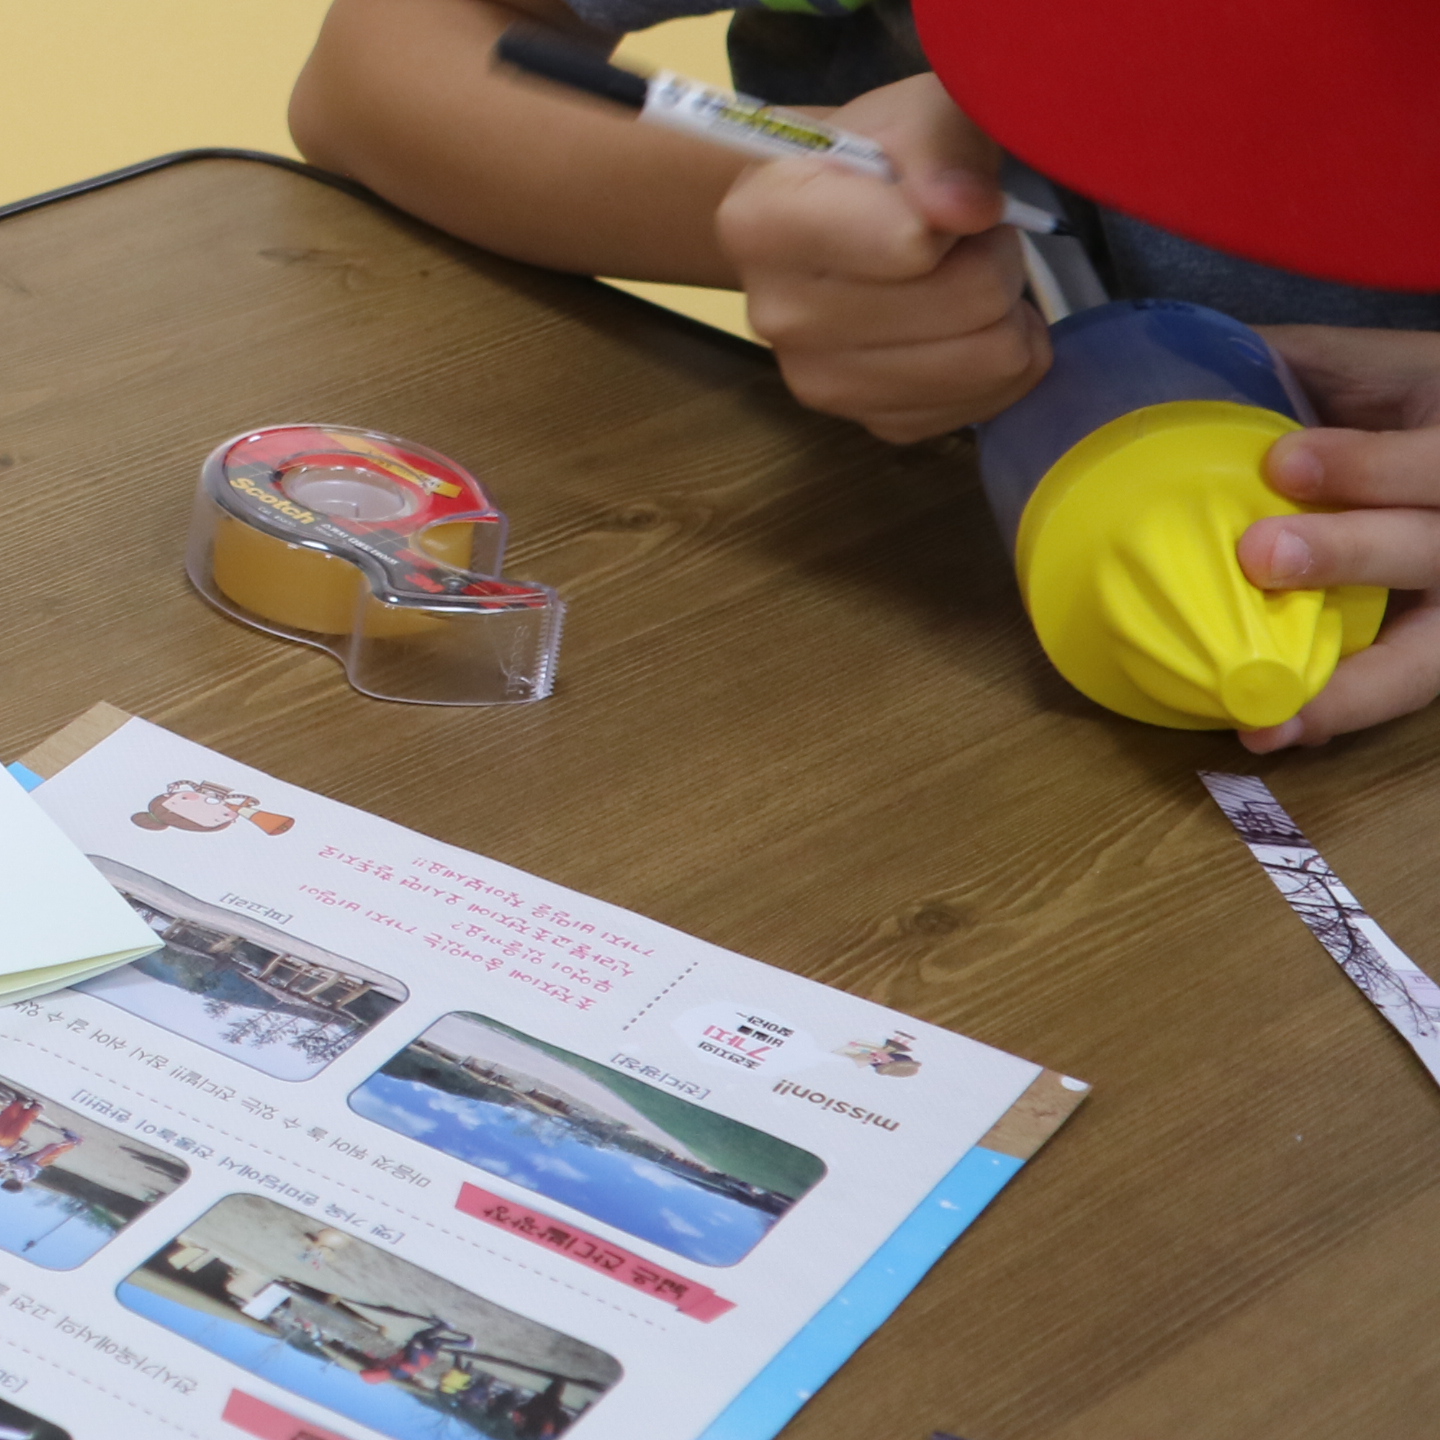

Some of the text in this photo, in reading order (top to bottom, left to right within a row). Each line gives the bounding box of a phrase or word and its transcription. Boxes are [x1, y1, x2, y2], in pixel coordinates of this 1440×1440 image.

[230, 476, 315, 525] Scotch
[216, 889, 294, 928] [파고라]
[298, 882, 362, 912] 비밀이
[316, 843, 635, 978] 신라불교초전지에 오시면 활동지로
[411, 856, 656, 958] 7가지 비밀을 찾아보세요!!
[365, 909, 418, 934] 7가지
[450, 918, 615, 994] 무엇이 있을까요?
[508, 968, 597, 1012] 초전지에
[45, 1010, 66, 1024] 수
[65, 1016, 90, 1034] 갈
[88, 1028, 128, 1052] 쉬어
[128, 1045, 170, 1070] 잠시
[696, 1040, 760, 1070] 초전지의
[702, 1024, 772, 1062] 7가지
[610, 1052, 712, 1102] [잔디광장]
[70, 1088, 134, 1124] 한판!!]
[238, 1094, 280, 1122] 있는
[280, 1114, 304, 1131] 수
[770, 1074, 902, 1137] mission!!
[134, 1118, 215, 1160] 전통놀이
[304, 1124, 330, 1143] 놀
[216, 1155, 320, 1207] 한마당에서
[323, 1202, 368, 1228] 가옥
[8, 1293, 56, 1322] 고전
[52, 1311, 200, 1398] 전시가옥에서의
